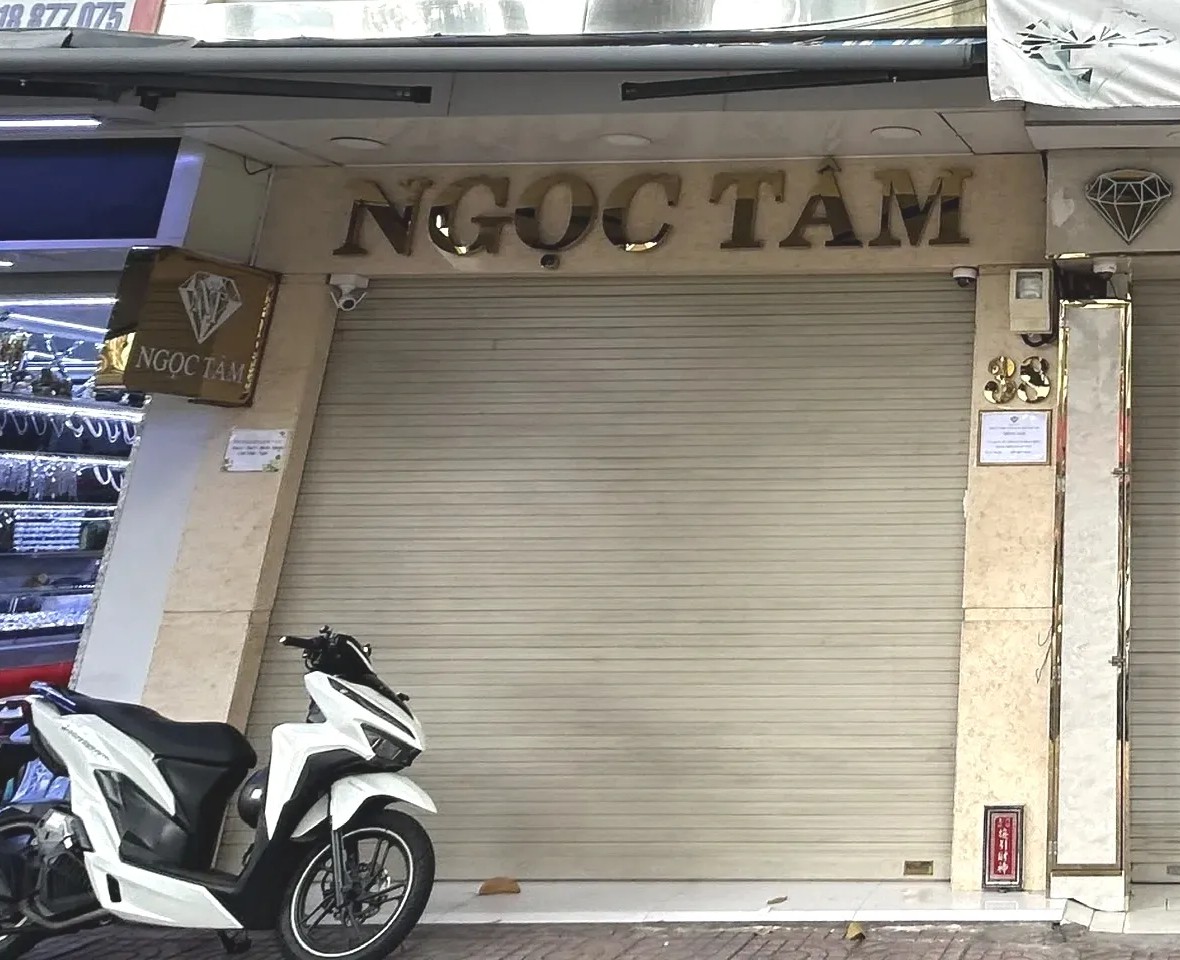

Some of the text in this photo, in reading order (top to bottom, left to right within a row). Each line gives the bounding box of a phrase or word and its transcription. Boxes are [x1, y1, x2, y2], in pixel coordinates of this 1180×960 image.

[332, 155, 973, 270] NGỌC TÂM
[135, 346, 246, 384] NGỌC TÂM
[983, 355, 1051, 404] 38
